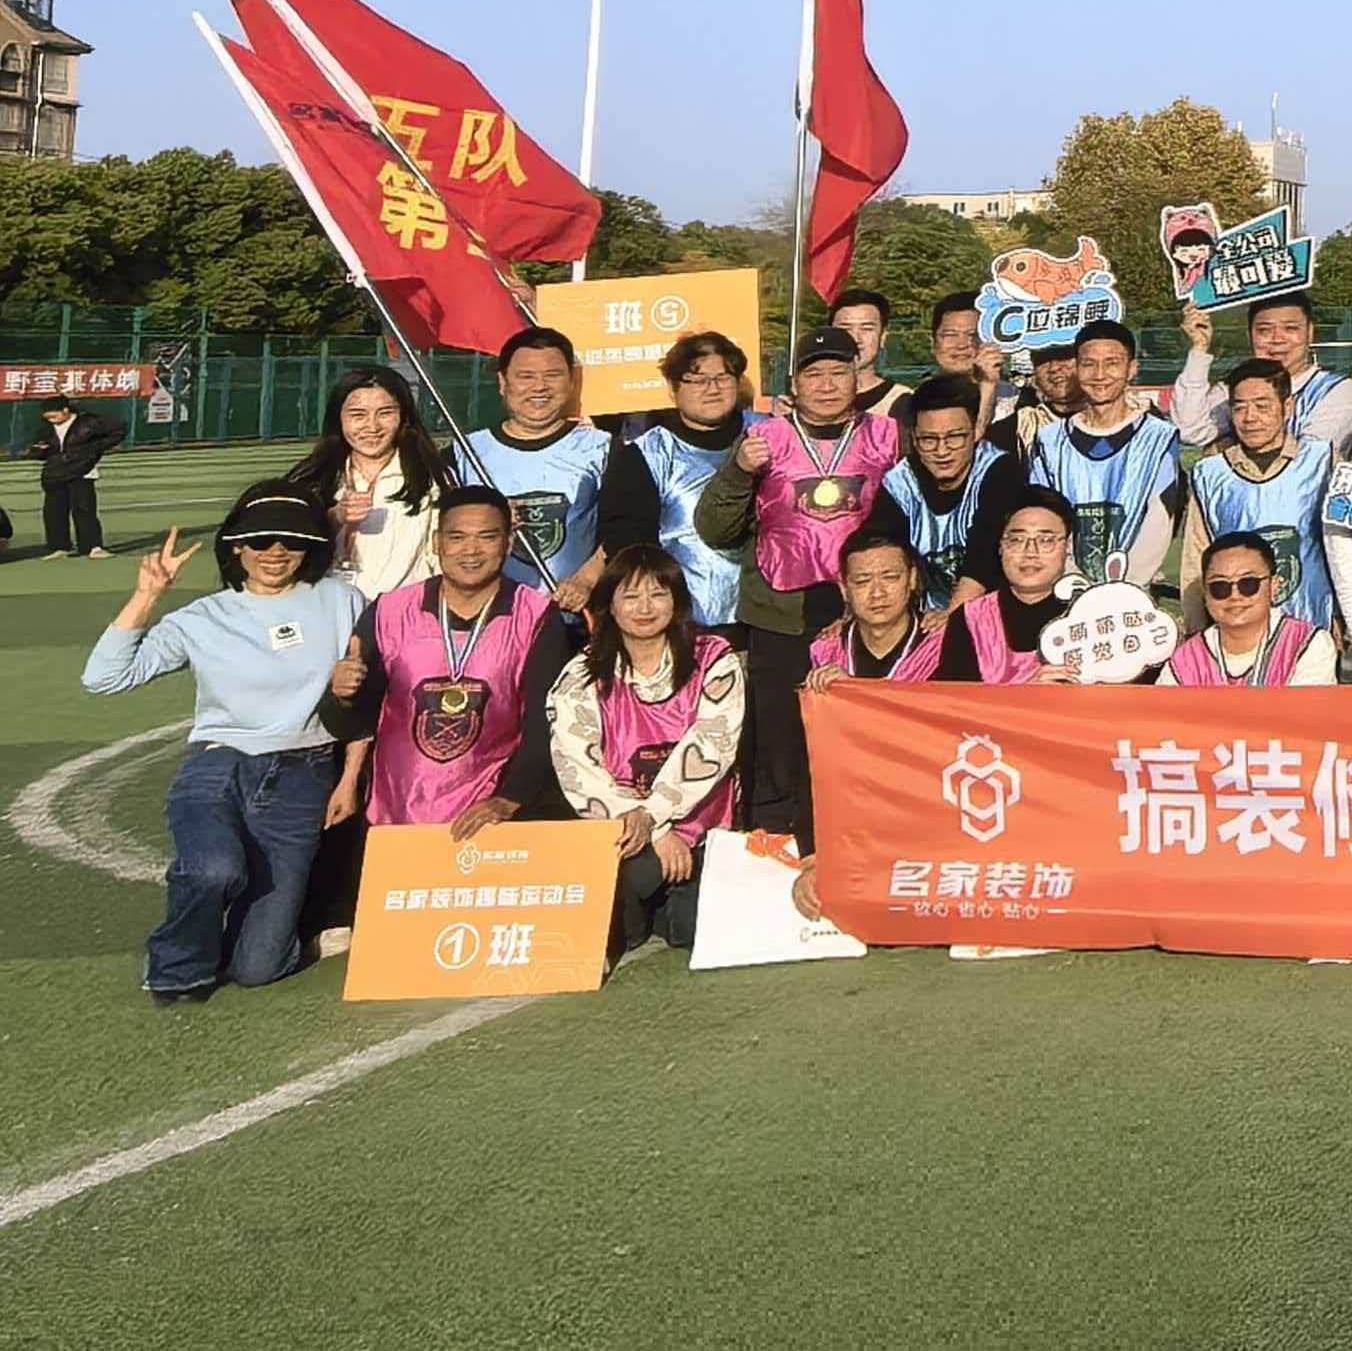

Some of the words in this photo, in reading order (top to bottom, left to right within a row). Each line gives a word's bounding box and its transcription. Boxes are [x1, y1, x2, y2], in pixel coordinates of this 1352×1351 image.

[1216, 226, 1280, 260] 全公司
[1212, 249, 1297, 297] 最可爱
[384, 882, 586, 912] 名家装饰趣味运动会
[888, 859, 1076, 899] 名家装饰
